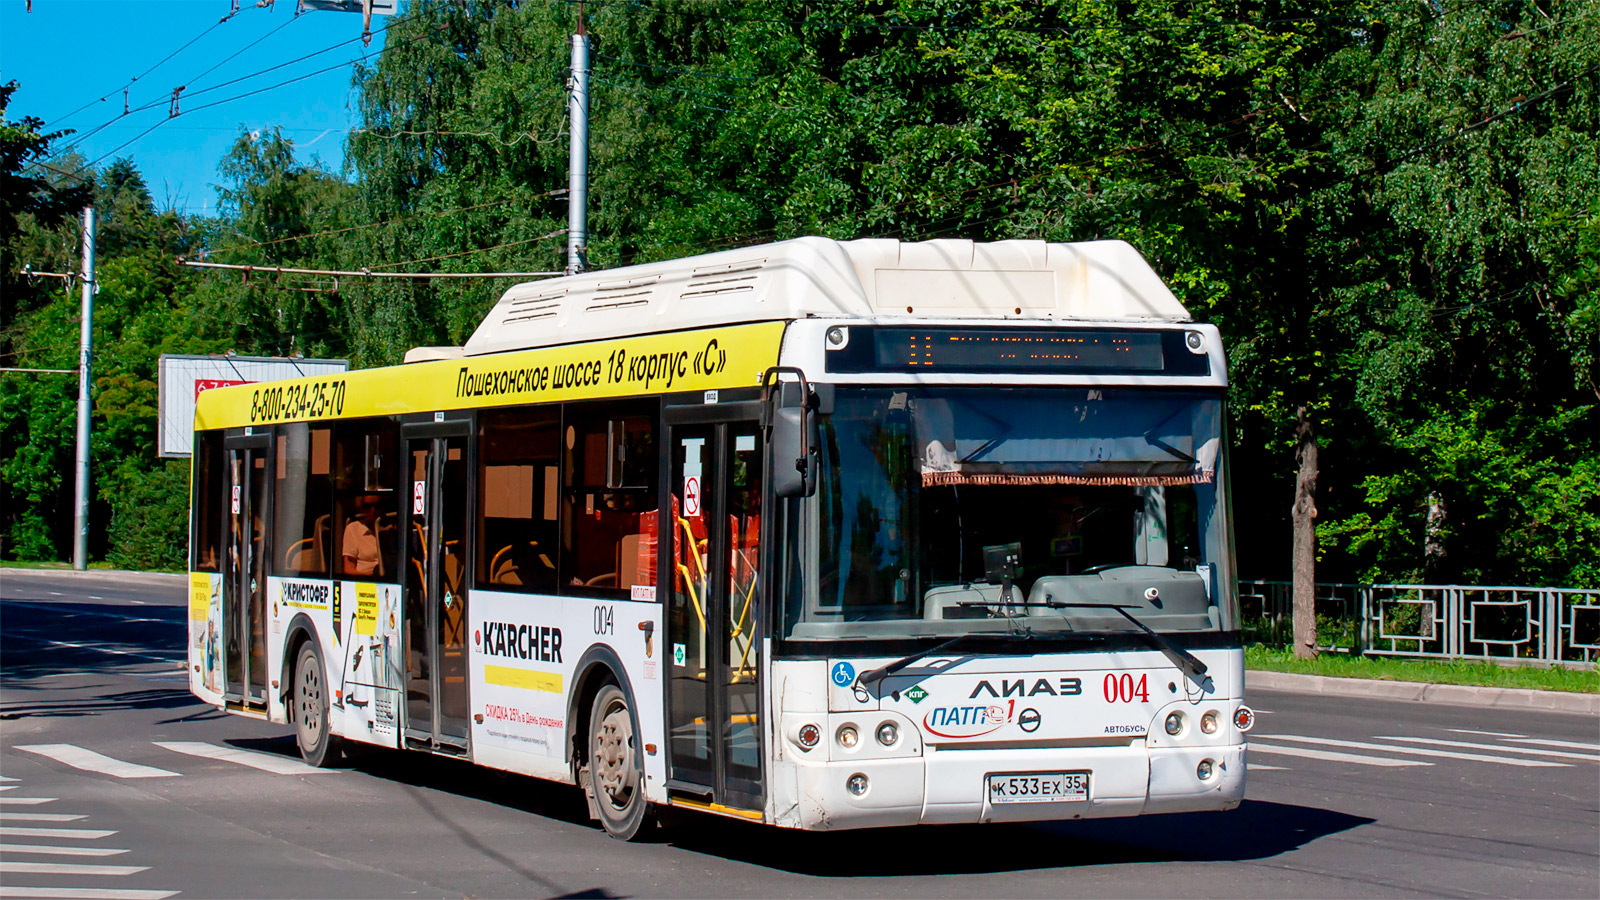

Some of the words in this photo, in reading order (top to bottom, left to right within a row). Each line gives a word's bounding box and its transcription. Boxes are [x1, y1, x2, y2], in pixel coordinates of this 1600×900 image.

[456, 366, 549, 398] Пошехонское
[552, 360, 601, 389] шоссе
[607, 349, 626, 383] 18
[628, 347, 688, 389] корпус
[693, 338, 727, 375] «С»
[250, 380, 346, 422] 8-800-234-25-70
[287, 582, 329, 604] КРИСТОФЕР
[334, 586, 340, 605] 5
[593, 605, 614, 636] 004
[483, 621, 564, 664] KÄRCHER
[909, 690, 925, 699] КПГ
[968, 677, 1083, 699] ЛИАЗ
[1103, 673, 1150, 704] 004
[485, 703, 509, 722] СКИДКА
[509, 707, 521, 723] 25%
[526, 711, 538, 726] День
[538, 716, 564, 729] рождения
[1065, 775, 1081, 789] 35
